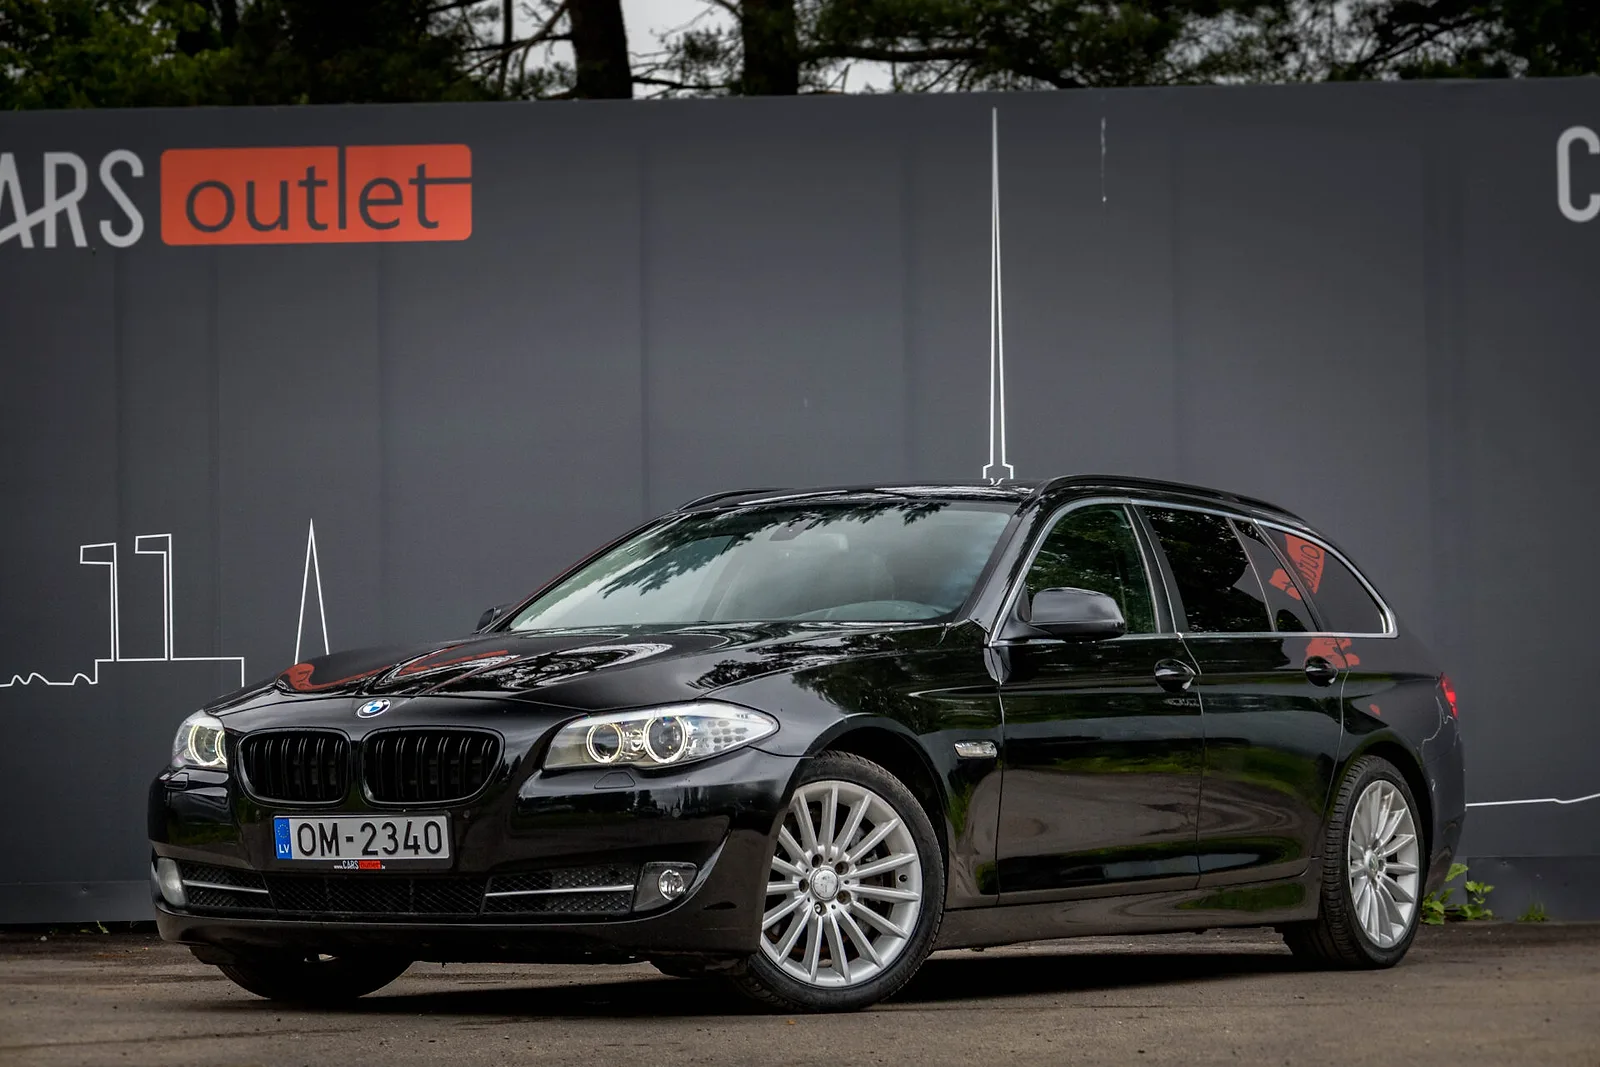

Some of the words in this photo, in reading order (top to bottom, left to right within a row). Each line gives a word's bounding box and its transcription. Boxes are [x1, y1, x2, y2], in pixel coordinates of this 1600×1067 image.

[185, 147, 472, 233] outlet
[278, 844, 290, 854] LV
[297, 820, 443, 857] OM-2340
